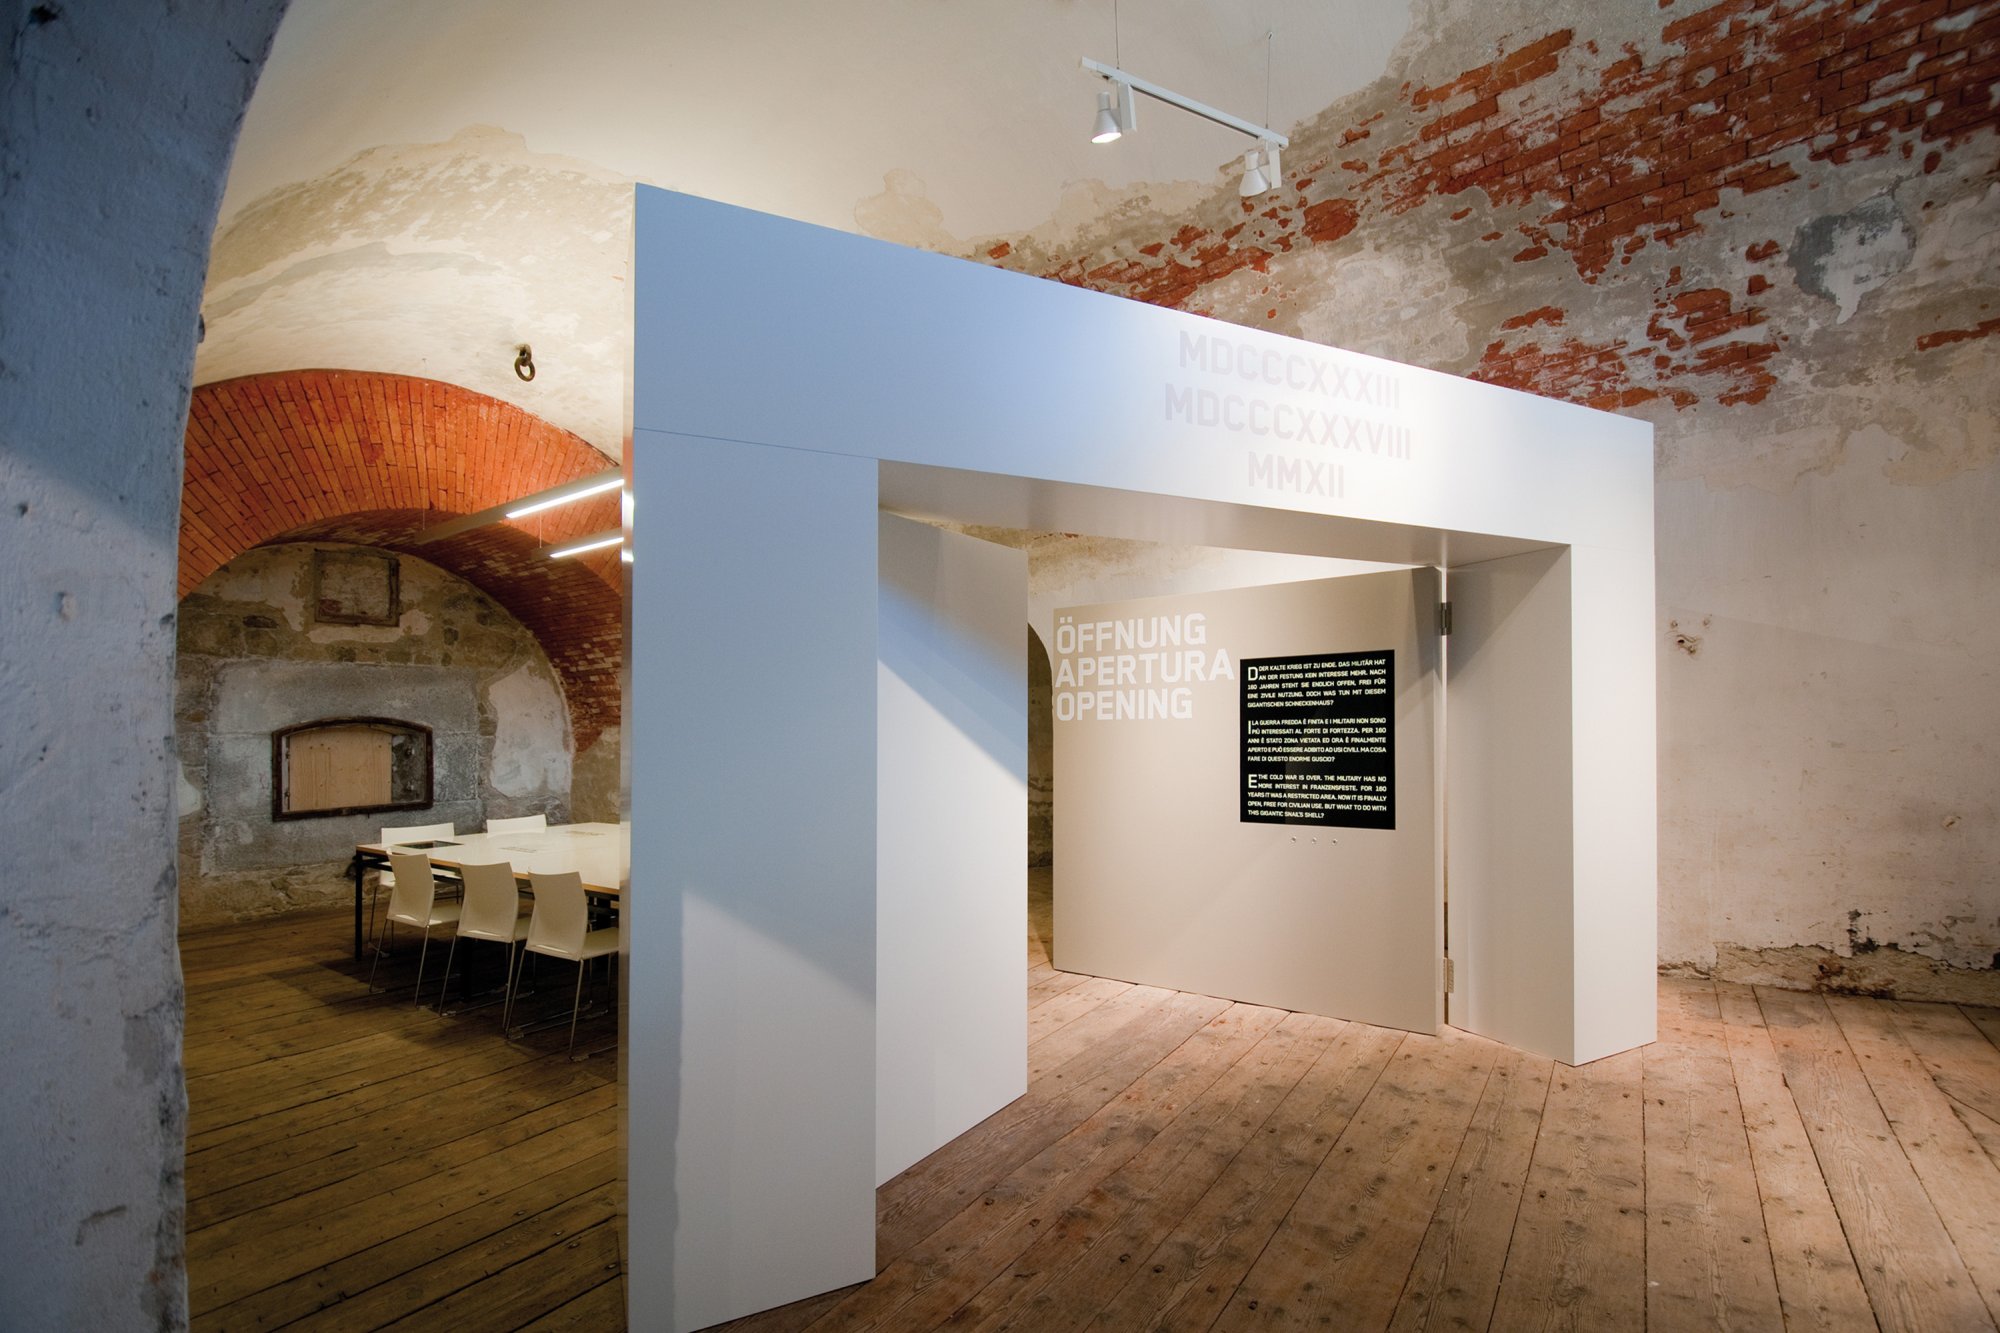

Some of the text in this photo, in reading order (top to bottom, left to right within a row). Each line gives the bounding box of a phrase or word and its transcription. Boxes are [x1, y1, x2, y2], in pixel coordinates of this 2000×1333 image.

[1179, 330, 1400, 410] MDCCCXXXIII
[1164, 383, 1411, 461] MDCCCXXXVIII
[1248, 451, 1345, 499] MMXII
[1056, 612, 1208, 654] ÖFFNUNG
[1055, 648, 1235, 688] APERTURA
[1248, 666, 1258, 680] D
[1056, 687, 1193, 721] OPENING
[1248, 720, 1251, 734] I
[1248, 774, 1257, 788] E
